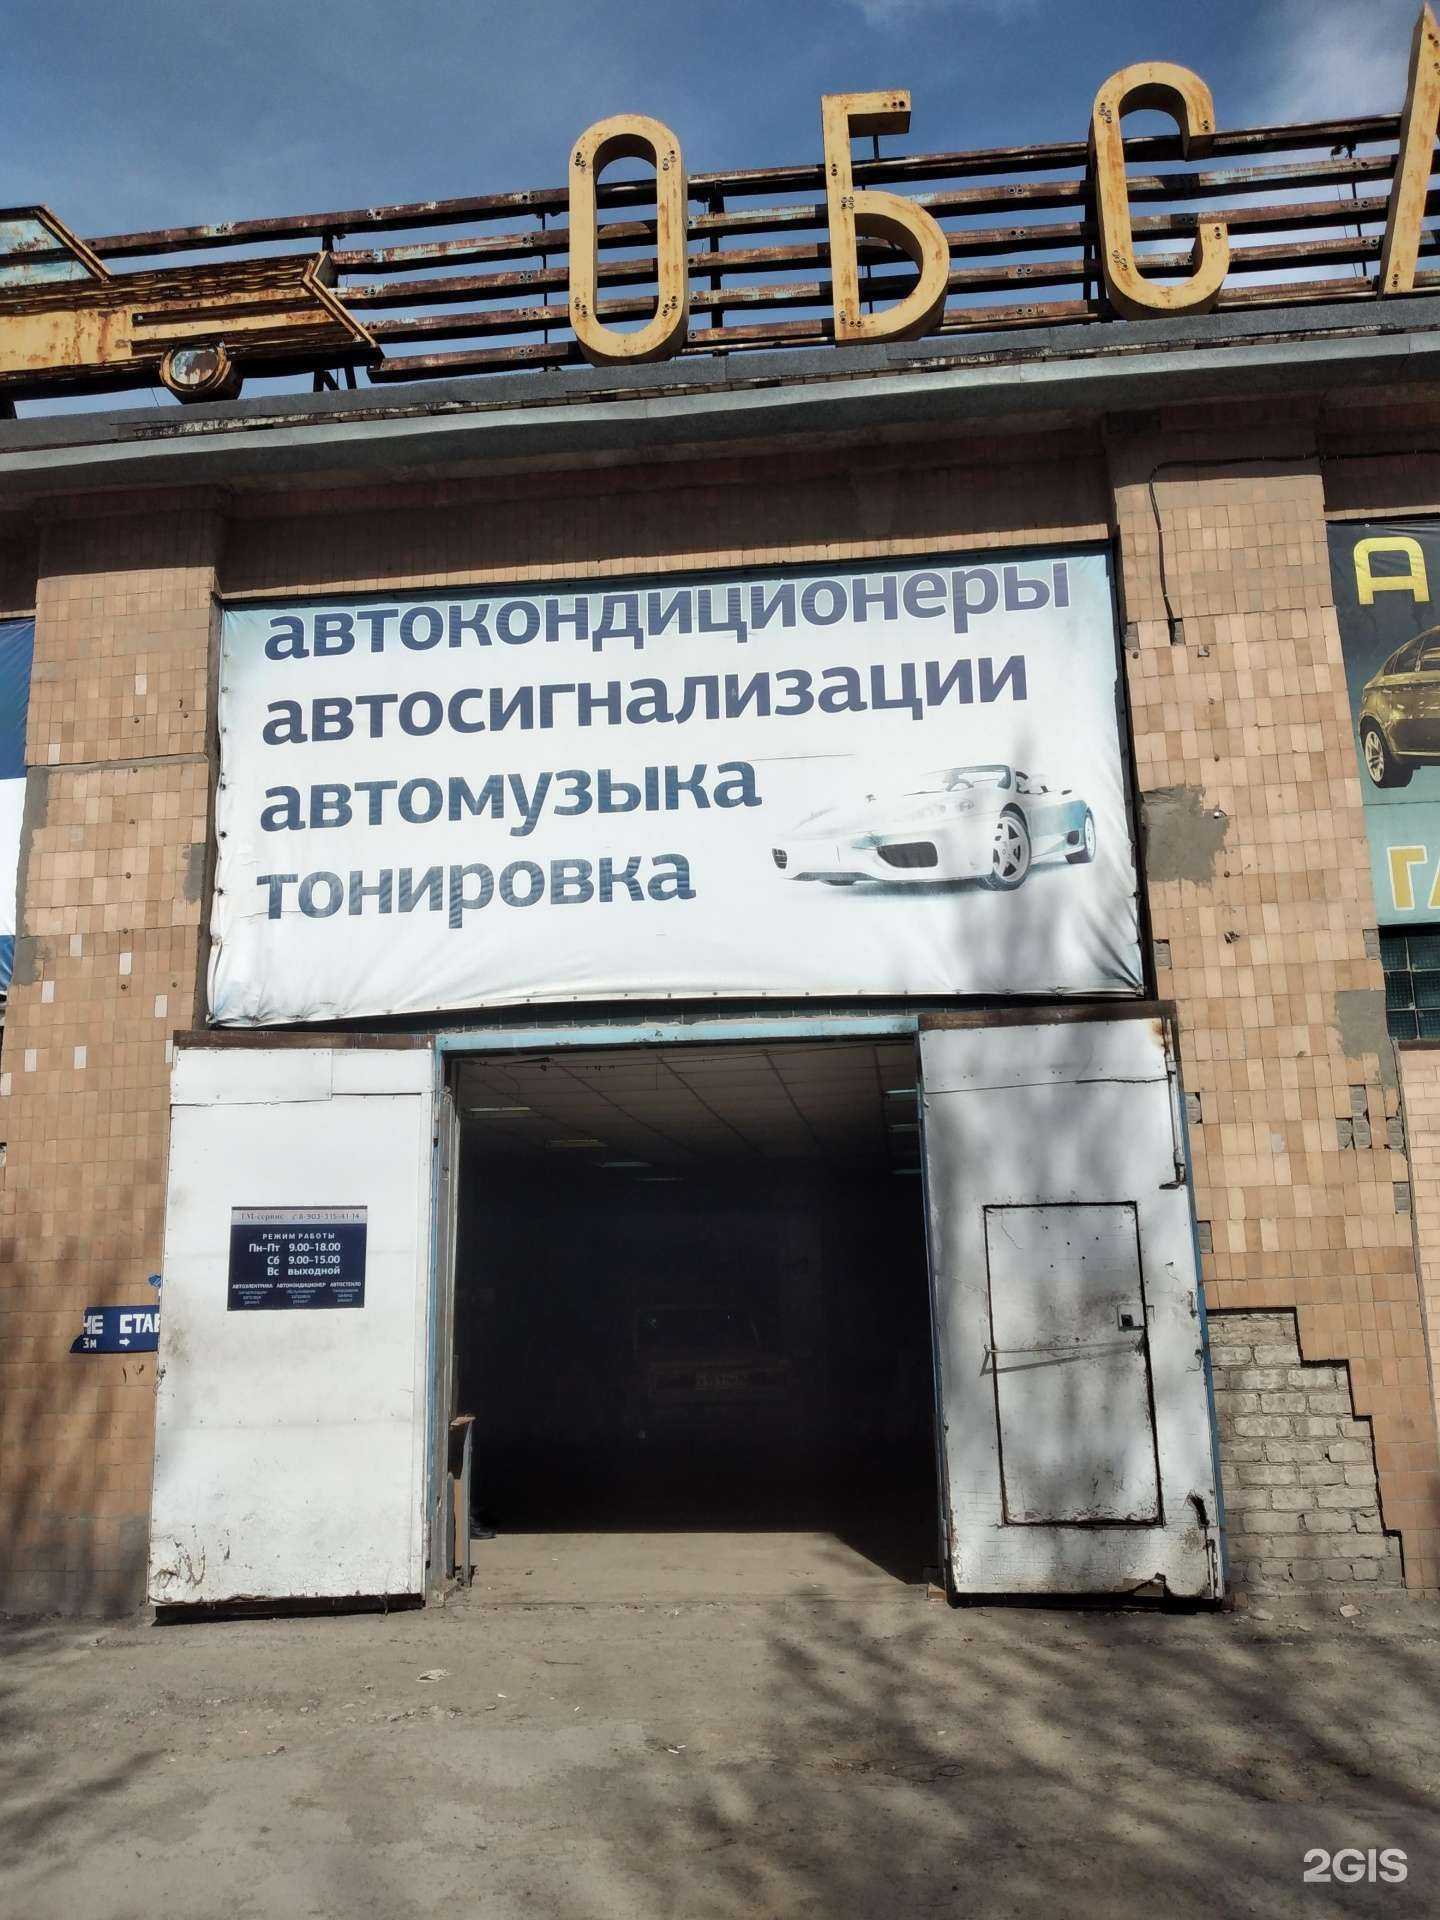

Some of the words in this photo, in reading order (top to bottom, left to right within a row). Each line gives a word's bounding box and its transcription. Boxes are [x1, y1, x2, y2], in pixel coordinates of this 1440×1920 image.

[264, 562, 1070, 661] автокондиционеры
[262, 654, 1028, 745] автосигнализации
[260, 759, 762, 837] автомузыка
[256, 851, 696, 929] тонировка
[1386, 844, 1440, 911] Г
[248, 1243, 280, 1253] Пн-Пт
[288, 1242, 341, 1252] 9.00-18.00
[267, 1256, 280, 1265] Сб
[288, 1255, 341, 1265] 9.00-15.00
[298, 1232, 336, 1240] РАБОТЫ
[267, 1267, 280, 1276] Вс
[287, 1265, 341, 1277] выходной
